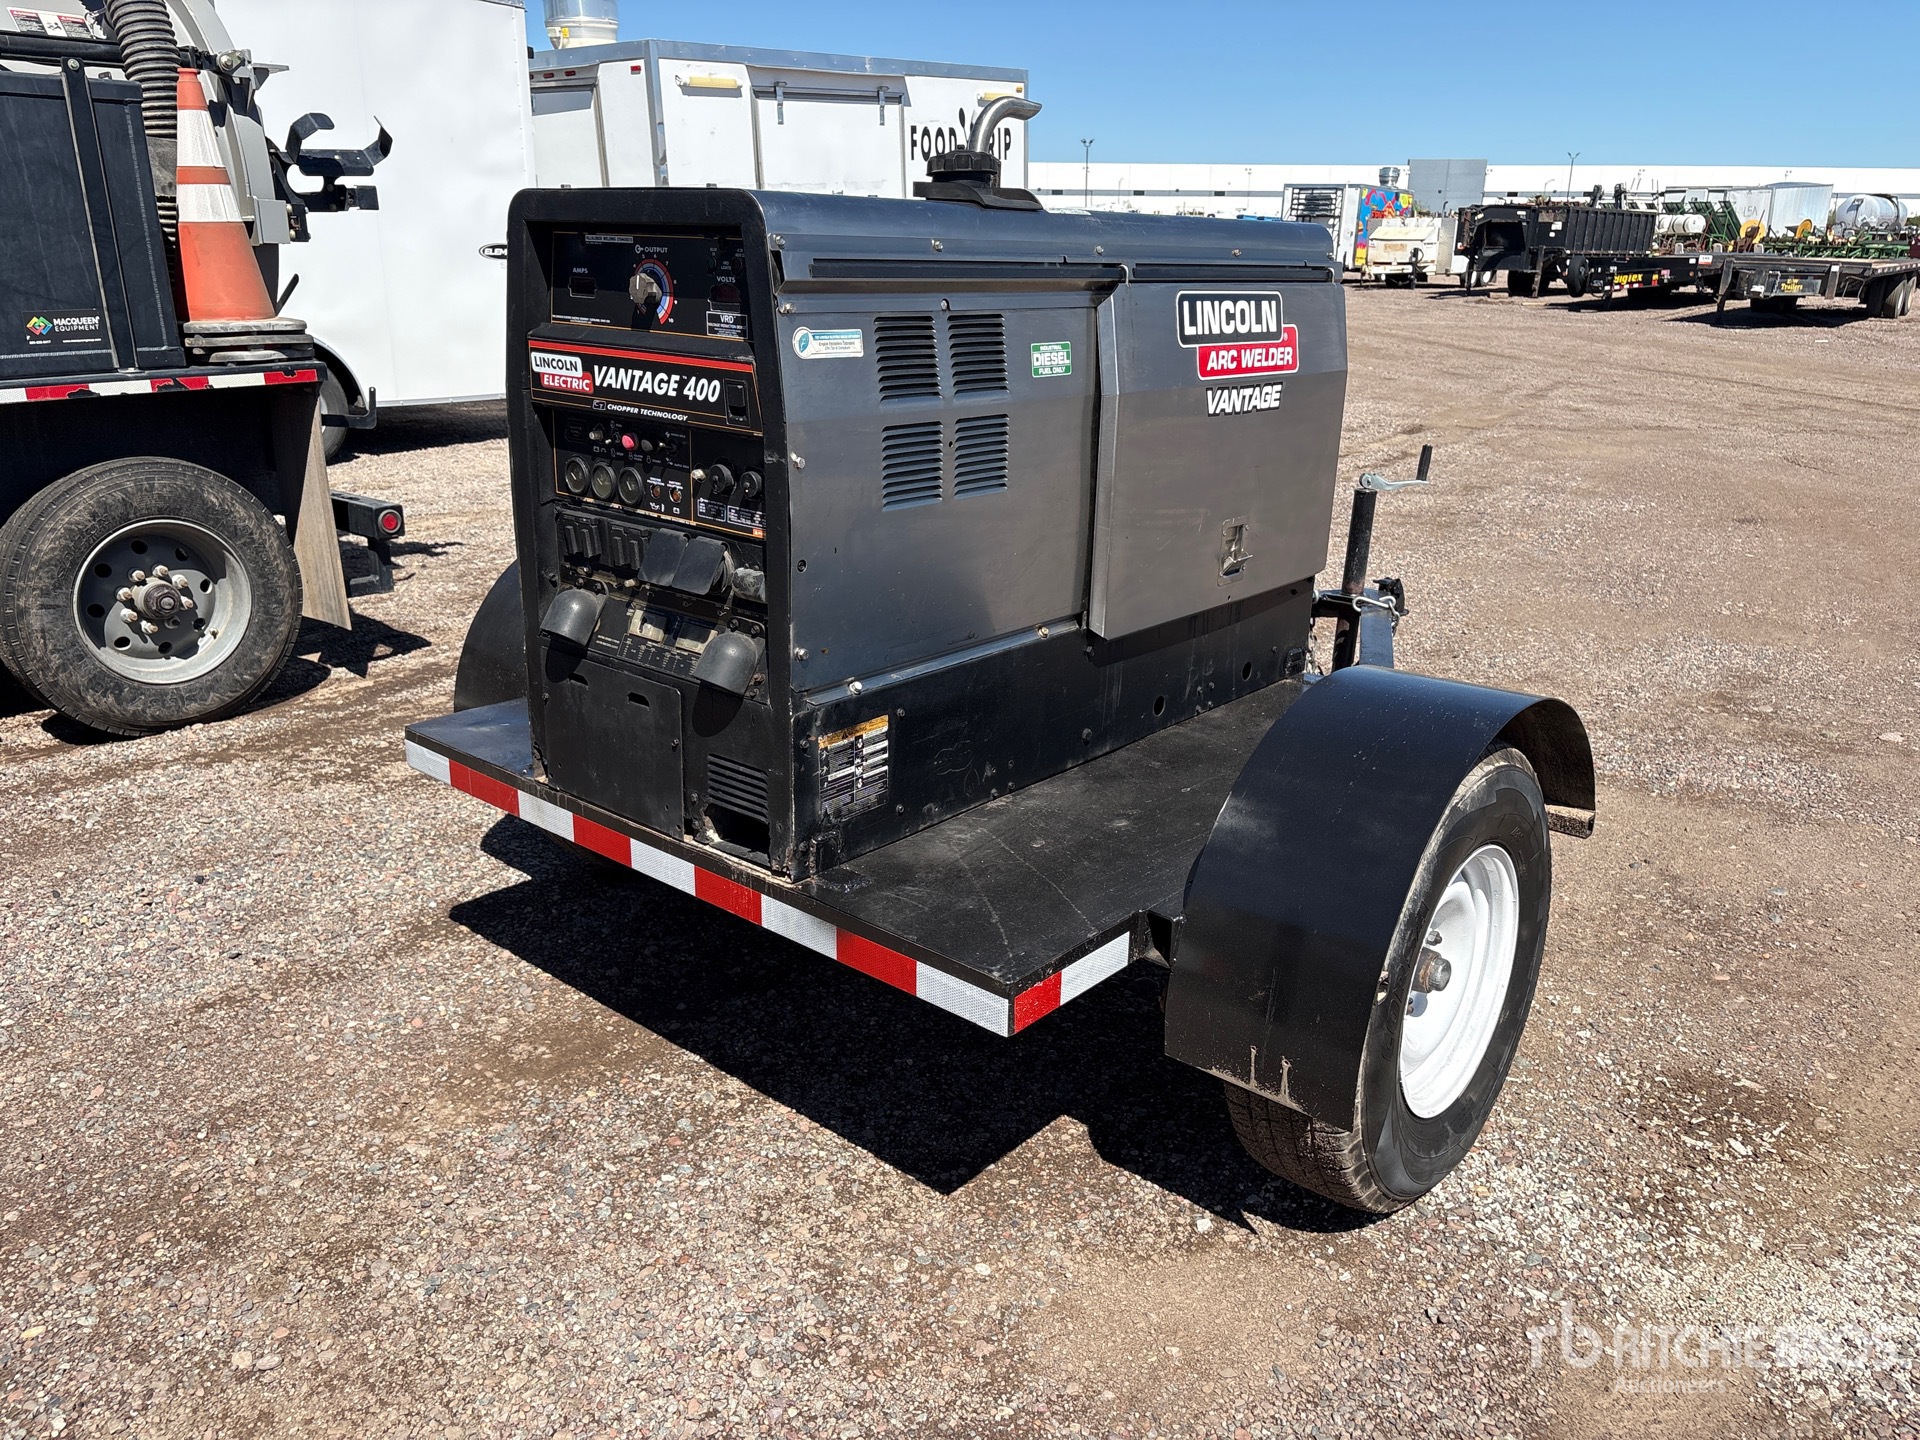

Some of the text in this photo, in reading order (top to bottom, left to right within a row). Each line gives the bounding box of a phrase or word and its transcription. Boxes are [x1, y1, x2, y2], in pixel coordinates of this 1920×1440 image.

[910, 125, 958, 162] FOOD
[644, 246, 668, 254] OUTPUT
[716, 275, 736, 283] VOLTS
[52, 316, 99, 326] MACQUEEN
[719, 314, 734, 324] VRD
[1182, 299, 1278, 336] LINCOLN
[54, 323, 99, 332] EQUIPMENT
[533, 355, 579, 373] LINCOLN
[1033, 351, 1070, 367] DIESEL
[1206, 346, 1293, 371] ARC WELDER
[1038, 366, 1066, 375] FUEL ONLY
[543, 373, 591, 392] ELECTRIC
[593, 364, 721, 404] VANTAGE 400
[1205, 382, 1284, 418] VANTAGE
[606, 402, 639, 415] CHOPPER
[640, 408, 689, 422] TECHNOLOGY
